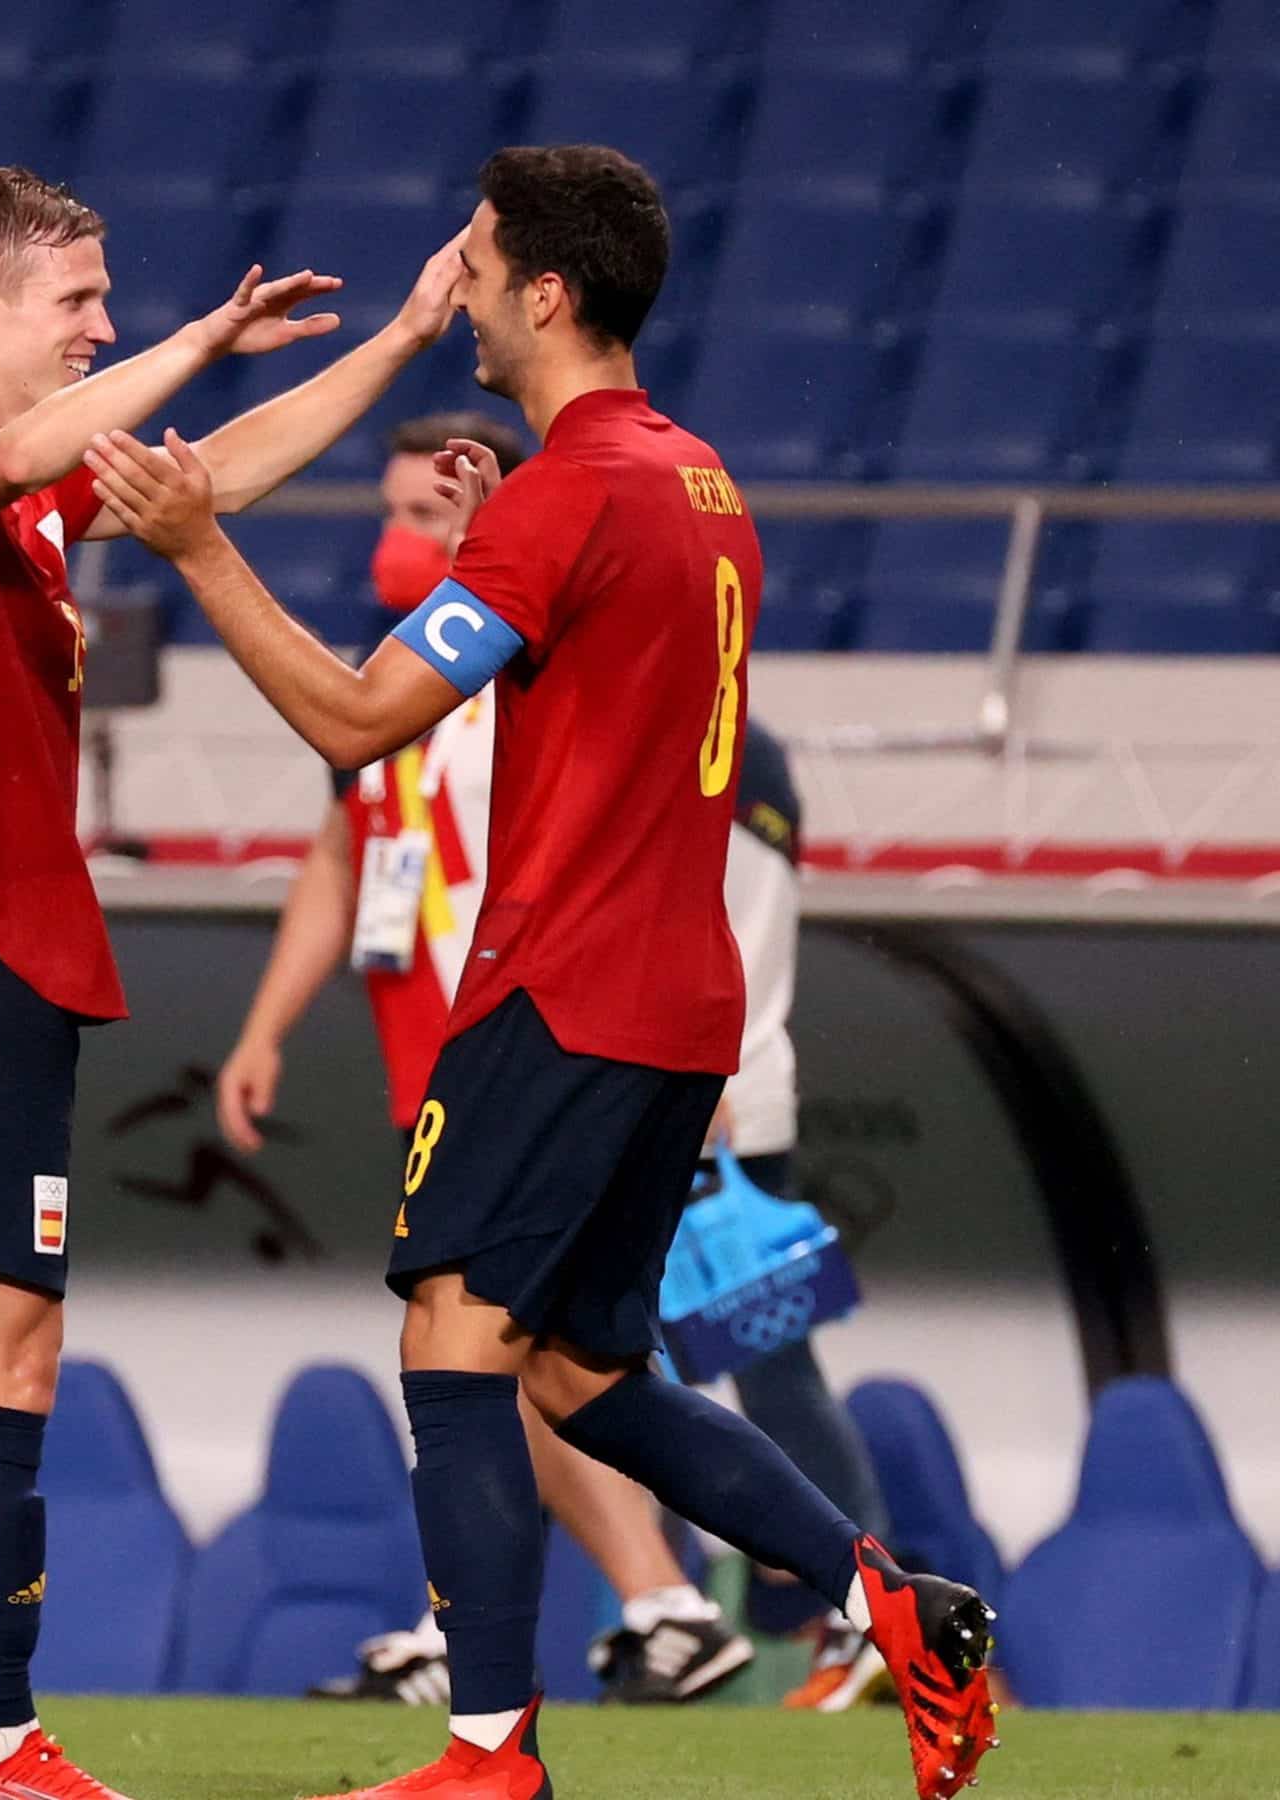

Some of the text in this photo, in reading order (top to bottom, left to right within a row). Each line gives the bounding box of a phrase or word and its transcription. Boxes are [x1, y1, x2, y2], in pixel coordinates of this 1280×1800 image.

[424, 601, 485, 664] C
[700, 556, 743, 797] 8
[405, 1099, 446, 1196] 8
